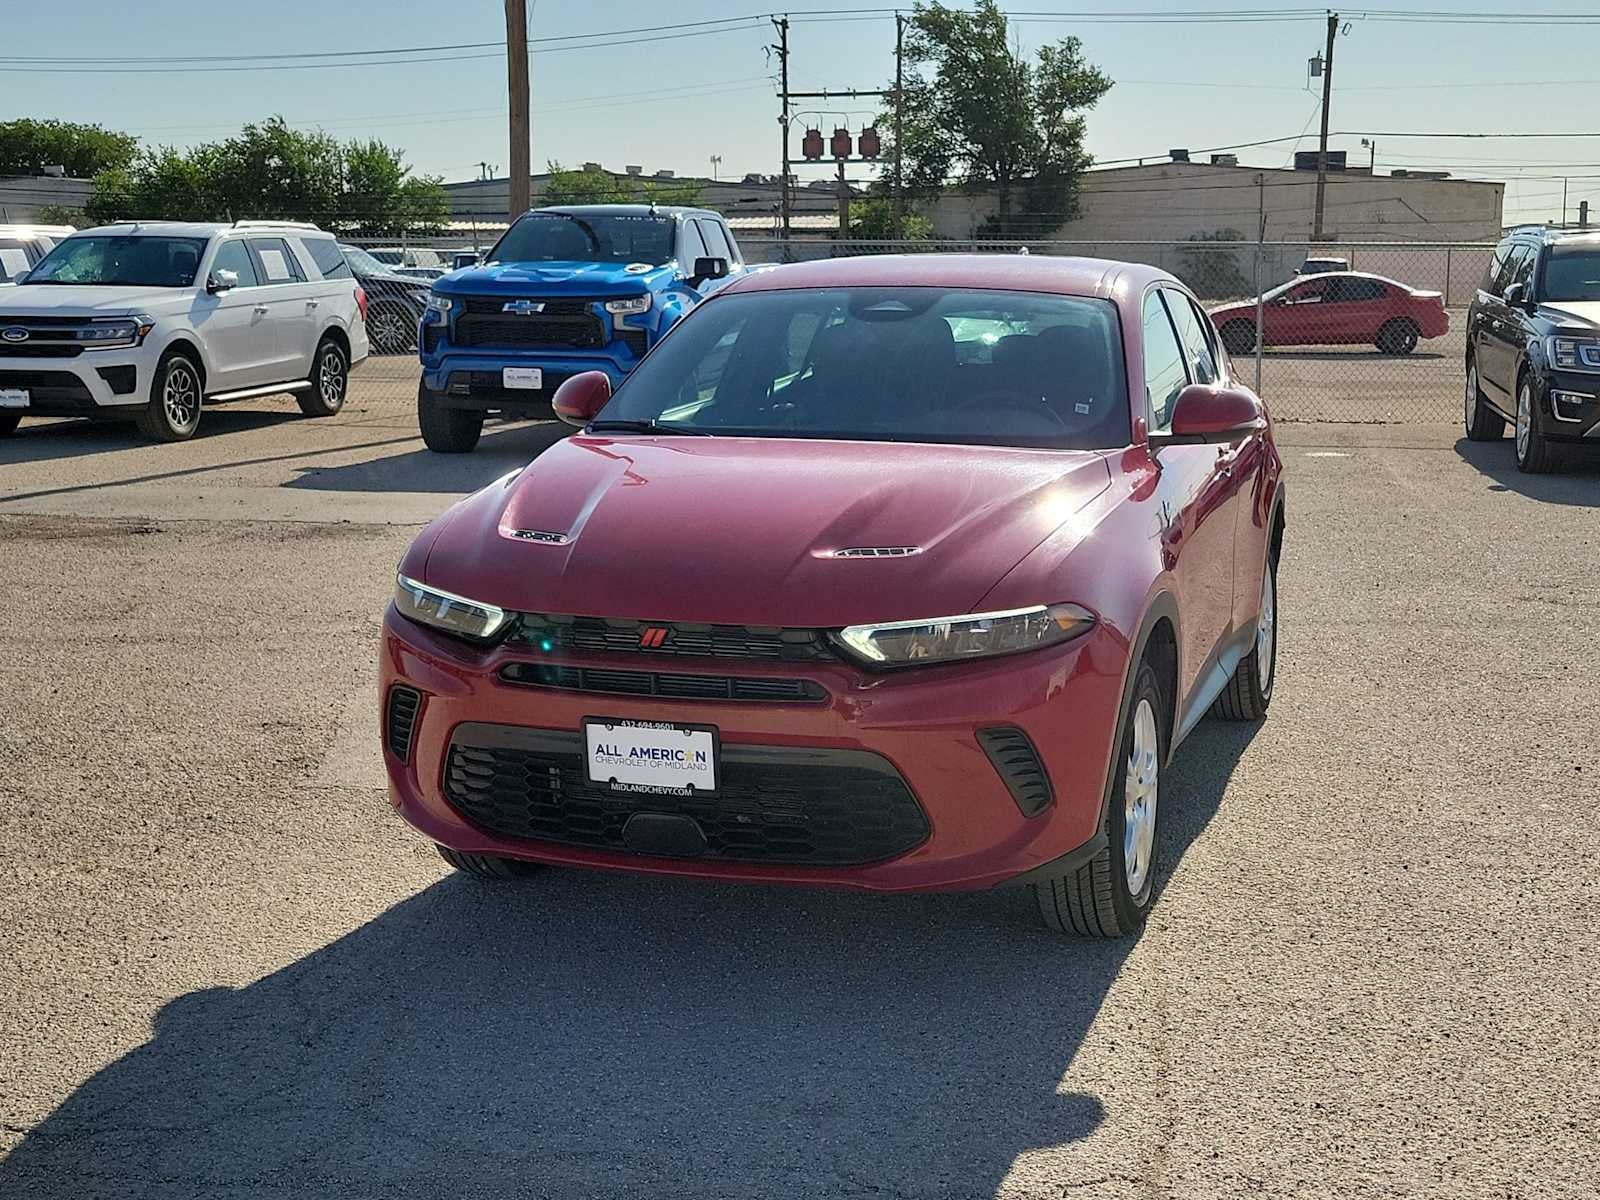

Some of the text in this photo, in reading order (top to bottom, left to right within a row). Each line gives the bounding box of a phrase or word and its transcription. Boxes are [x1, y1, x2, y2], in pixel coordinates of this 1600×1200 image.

[620, 720, 675, 731] 432-694-9601
[595, 743, 622, 757] ALL
[595, 755, 707, 771] CHEVROLET OF MIDLAND
[610, 782, 693, 797] MIDLANDCHEVY.COM
